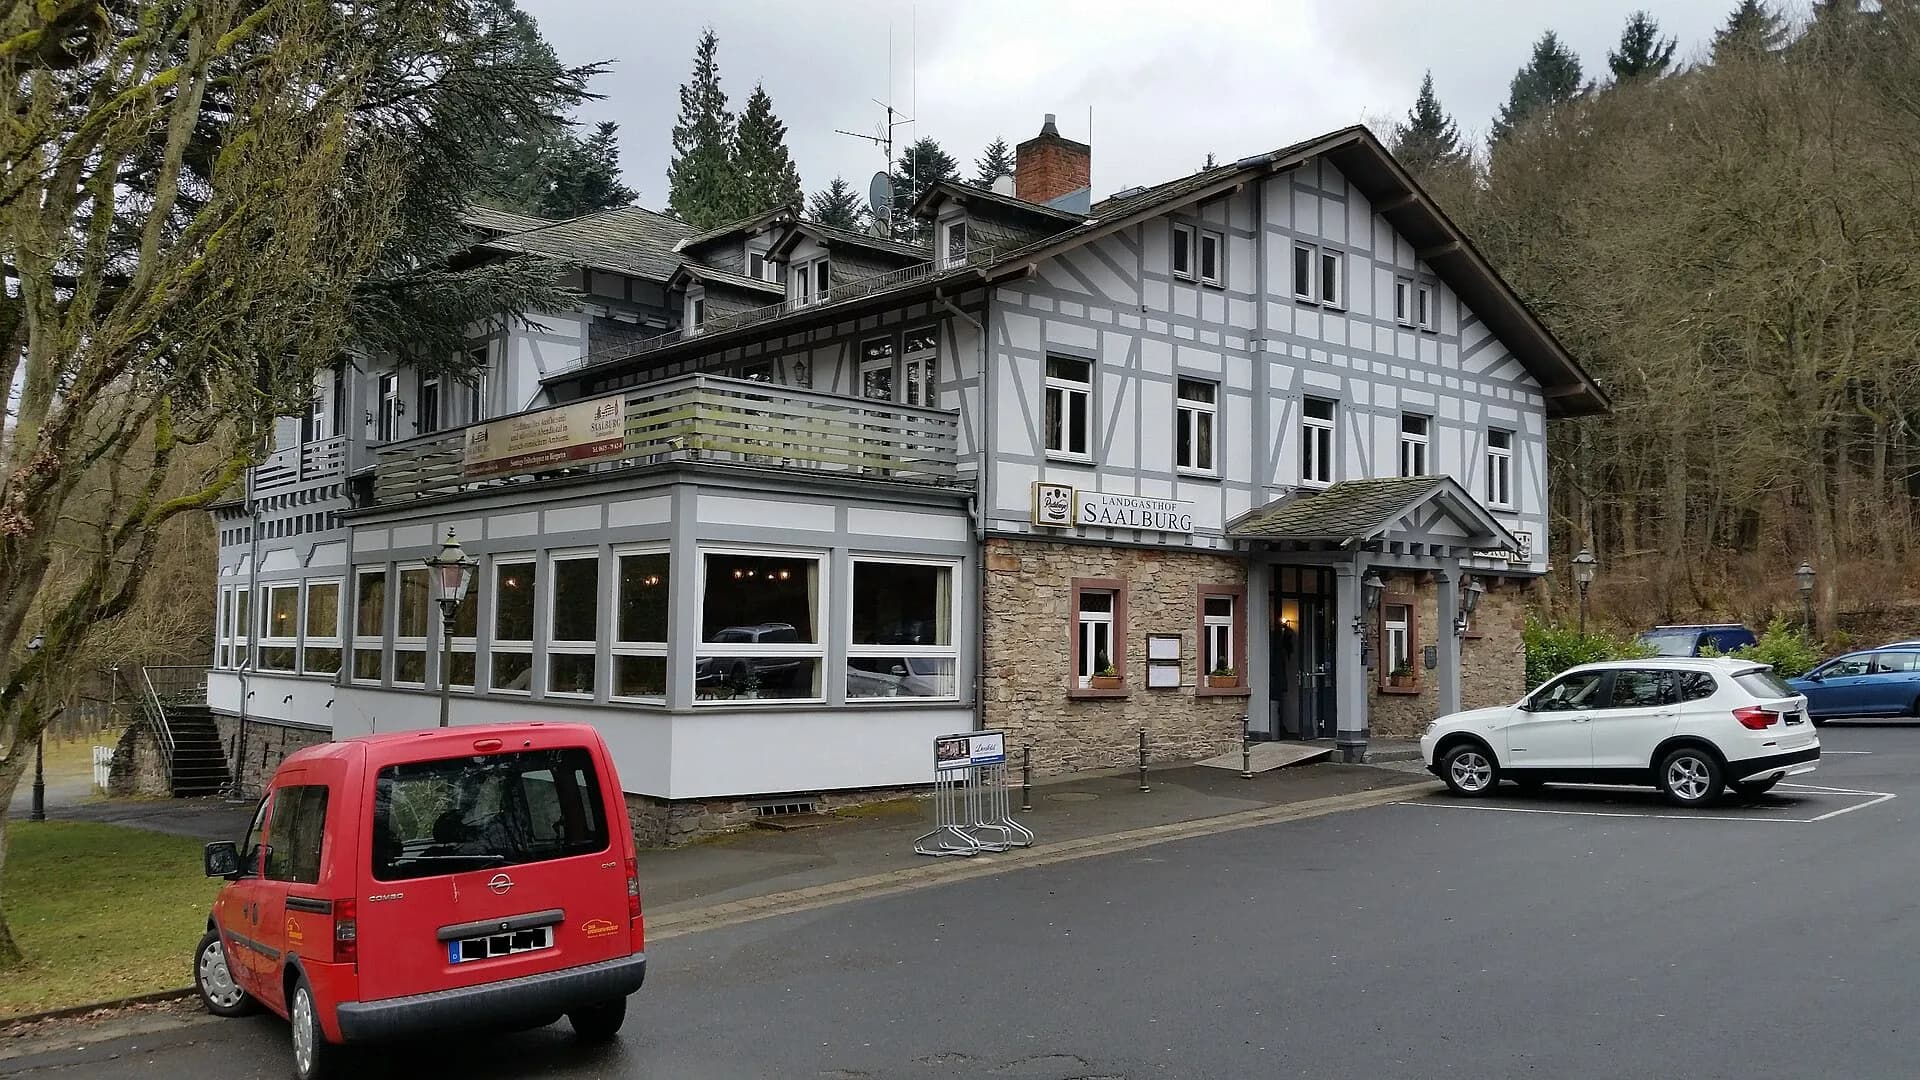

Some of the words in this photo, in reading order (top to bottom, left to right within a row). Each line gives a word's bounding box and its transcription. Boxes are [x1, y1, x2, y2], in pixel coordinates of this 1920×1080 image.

[1102, 496, 1177, 511] LANDGASTHOF
[1084, 503, 1192, 531] SAALBURG
[369, 892, 404, 902] COMBO
